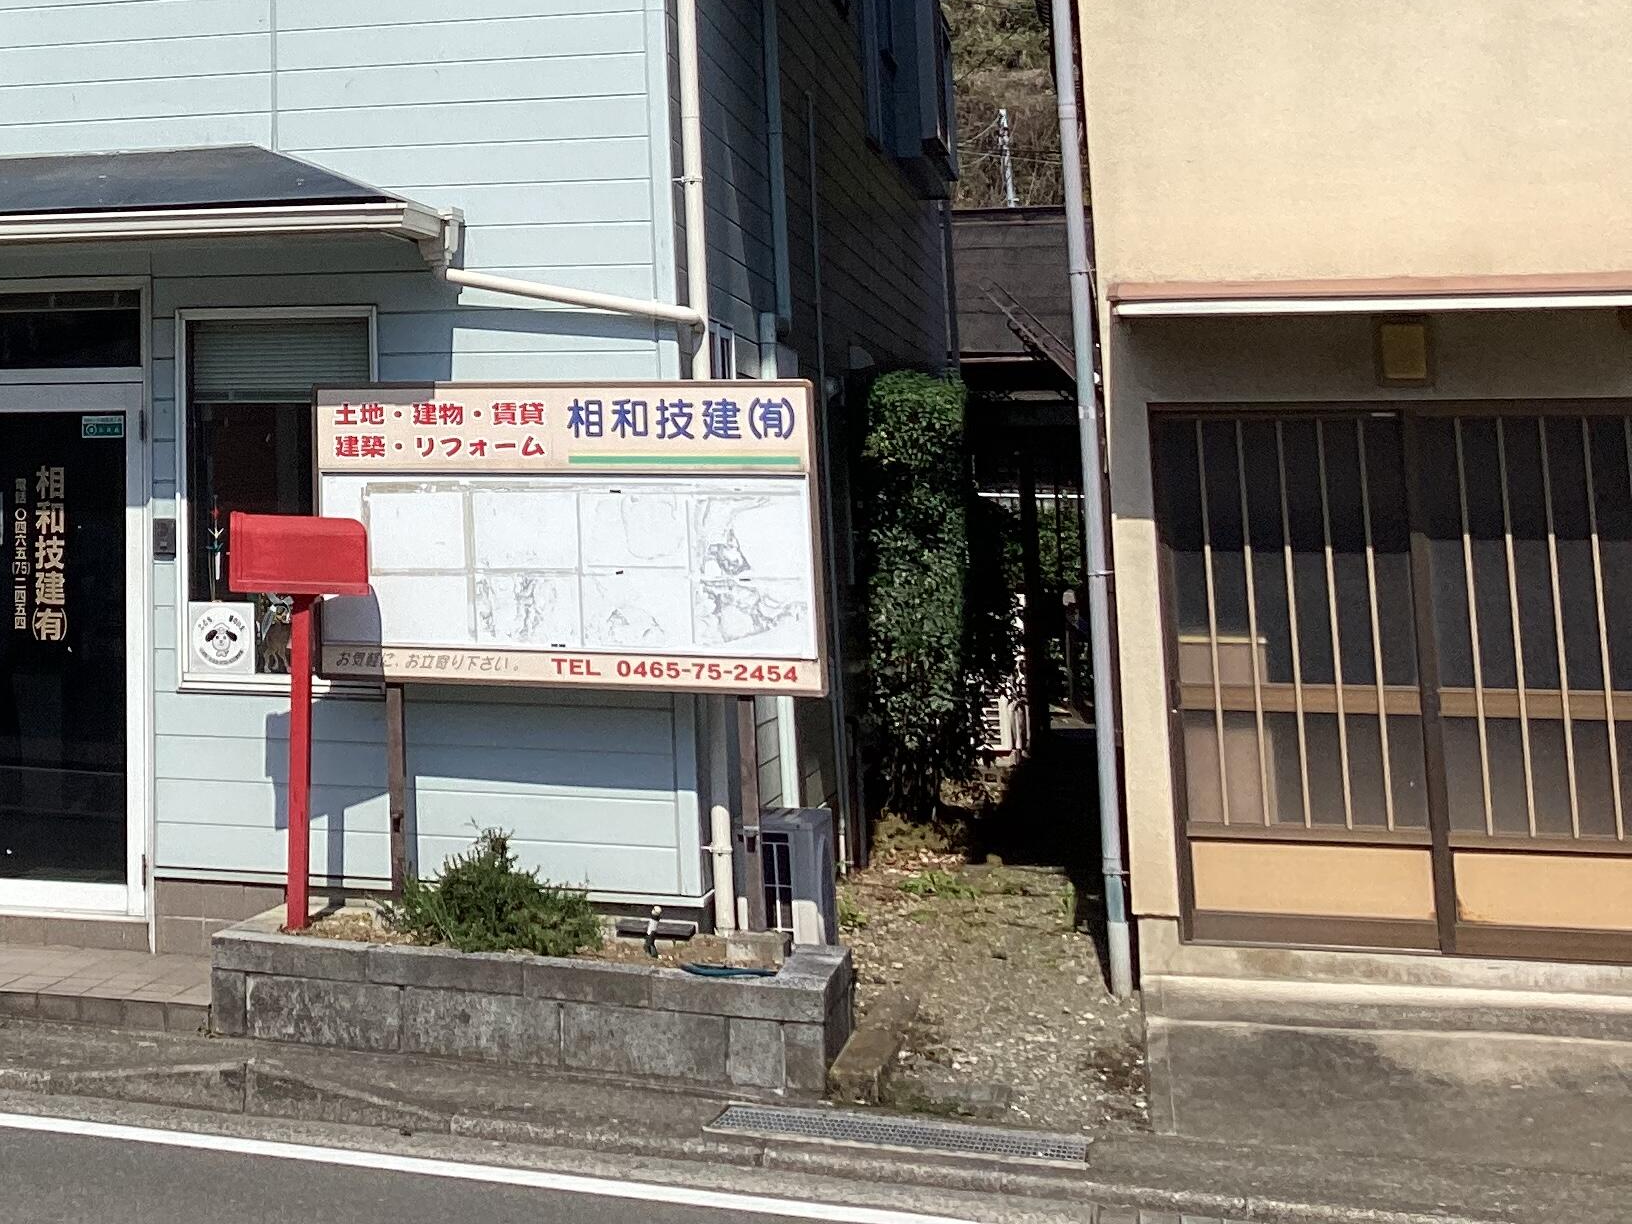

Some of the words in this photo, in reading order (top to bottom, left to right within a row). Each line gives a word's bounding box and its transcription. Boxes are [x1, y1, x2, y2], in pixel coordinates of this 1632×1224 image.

[334, 402, 545, 426] 土地・建物・賃貸
[335, 435, 546, 458] 建築・リフォーム
[551, 658, 602, 677] TEL
[616, 660, 799, 683] 0465-75-2454
